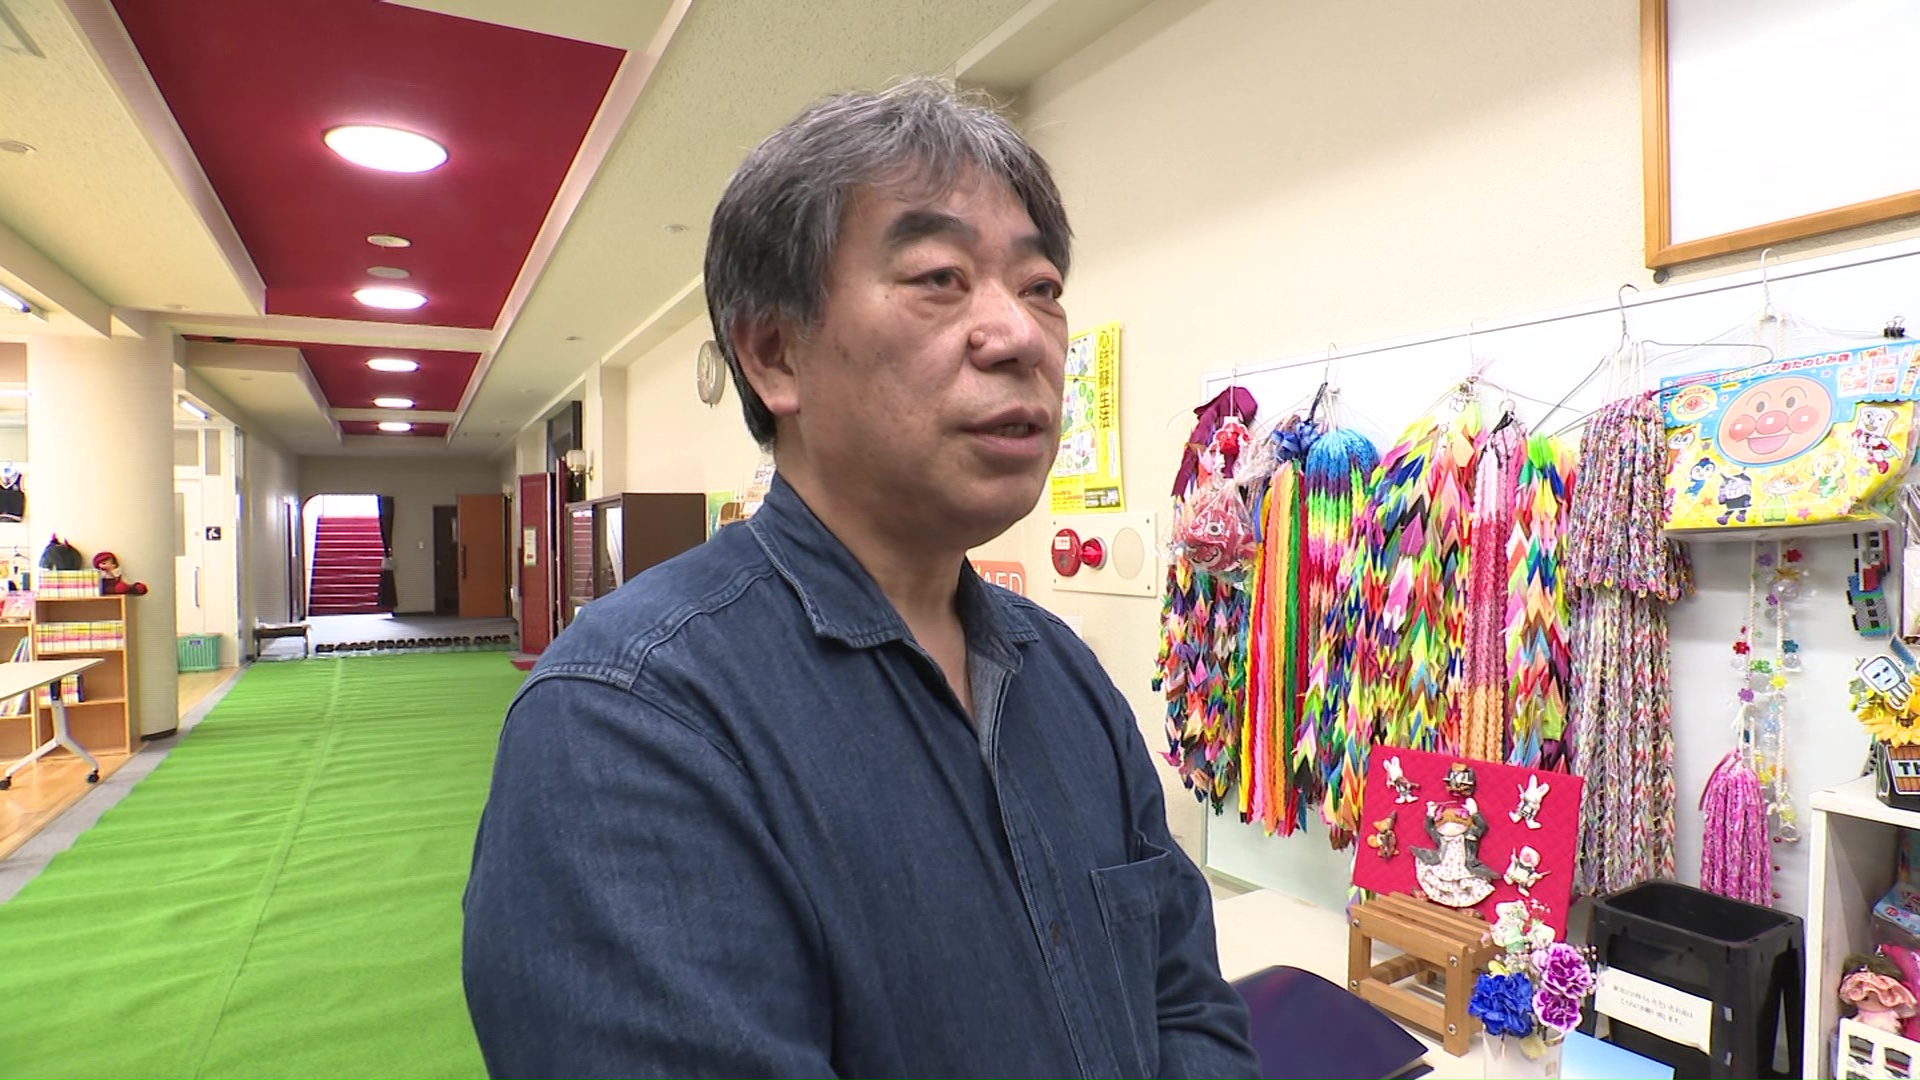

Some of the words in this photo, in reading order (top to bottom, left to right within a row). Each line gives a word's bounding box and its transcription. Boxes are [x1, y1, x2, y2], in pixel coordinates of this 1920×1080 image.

[1099, 330, 1110, 429] 心肺蘇生法
